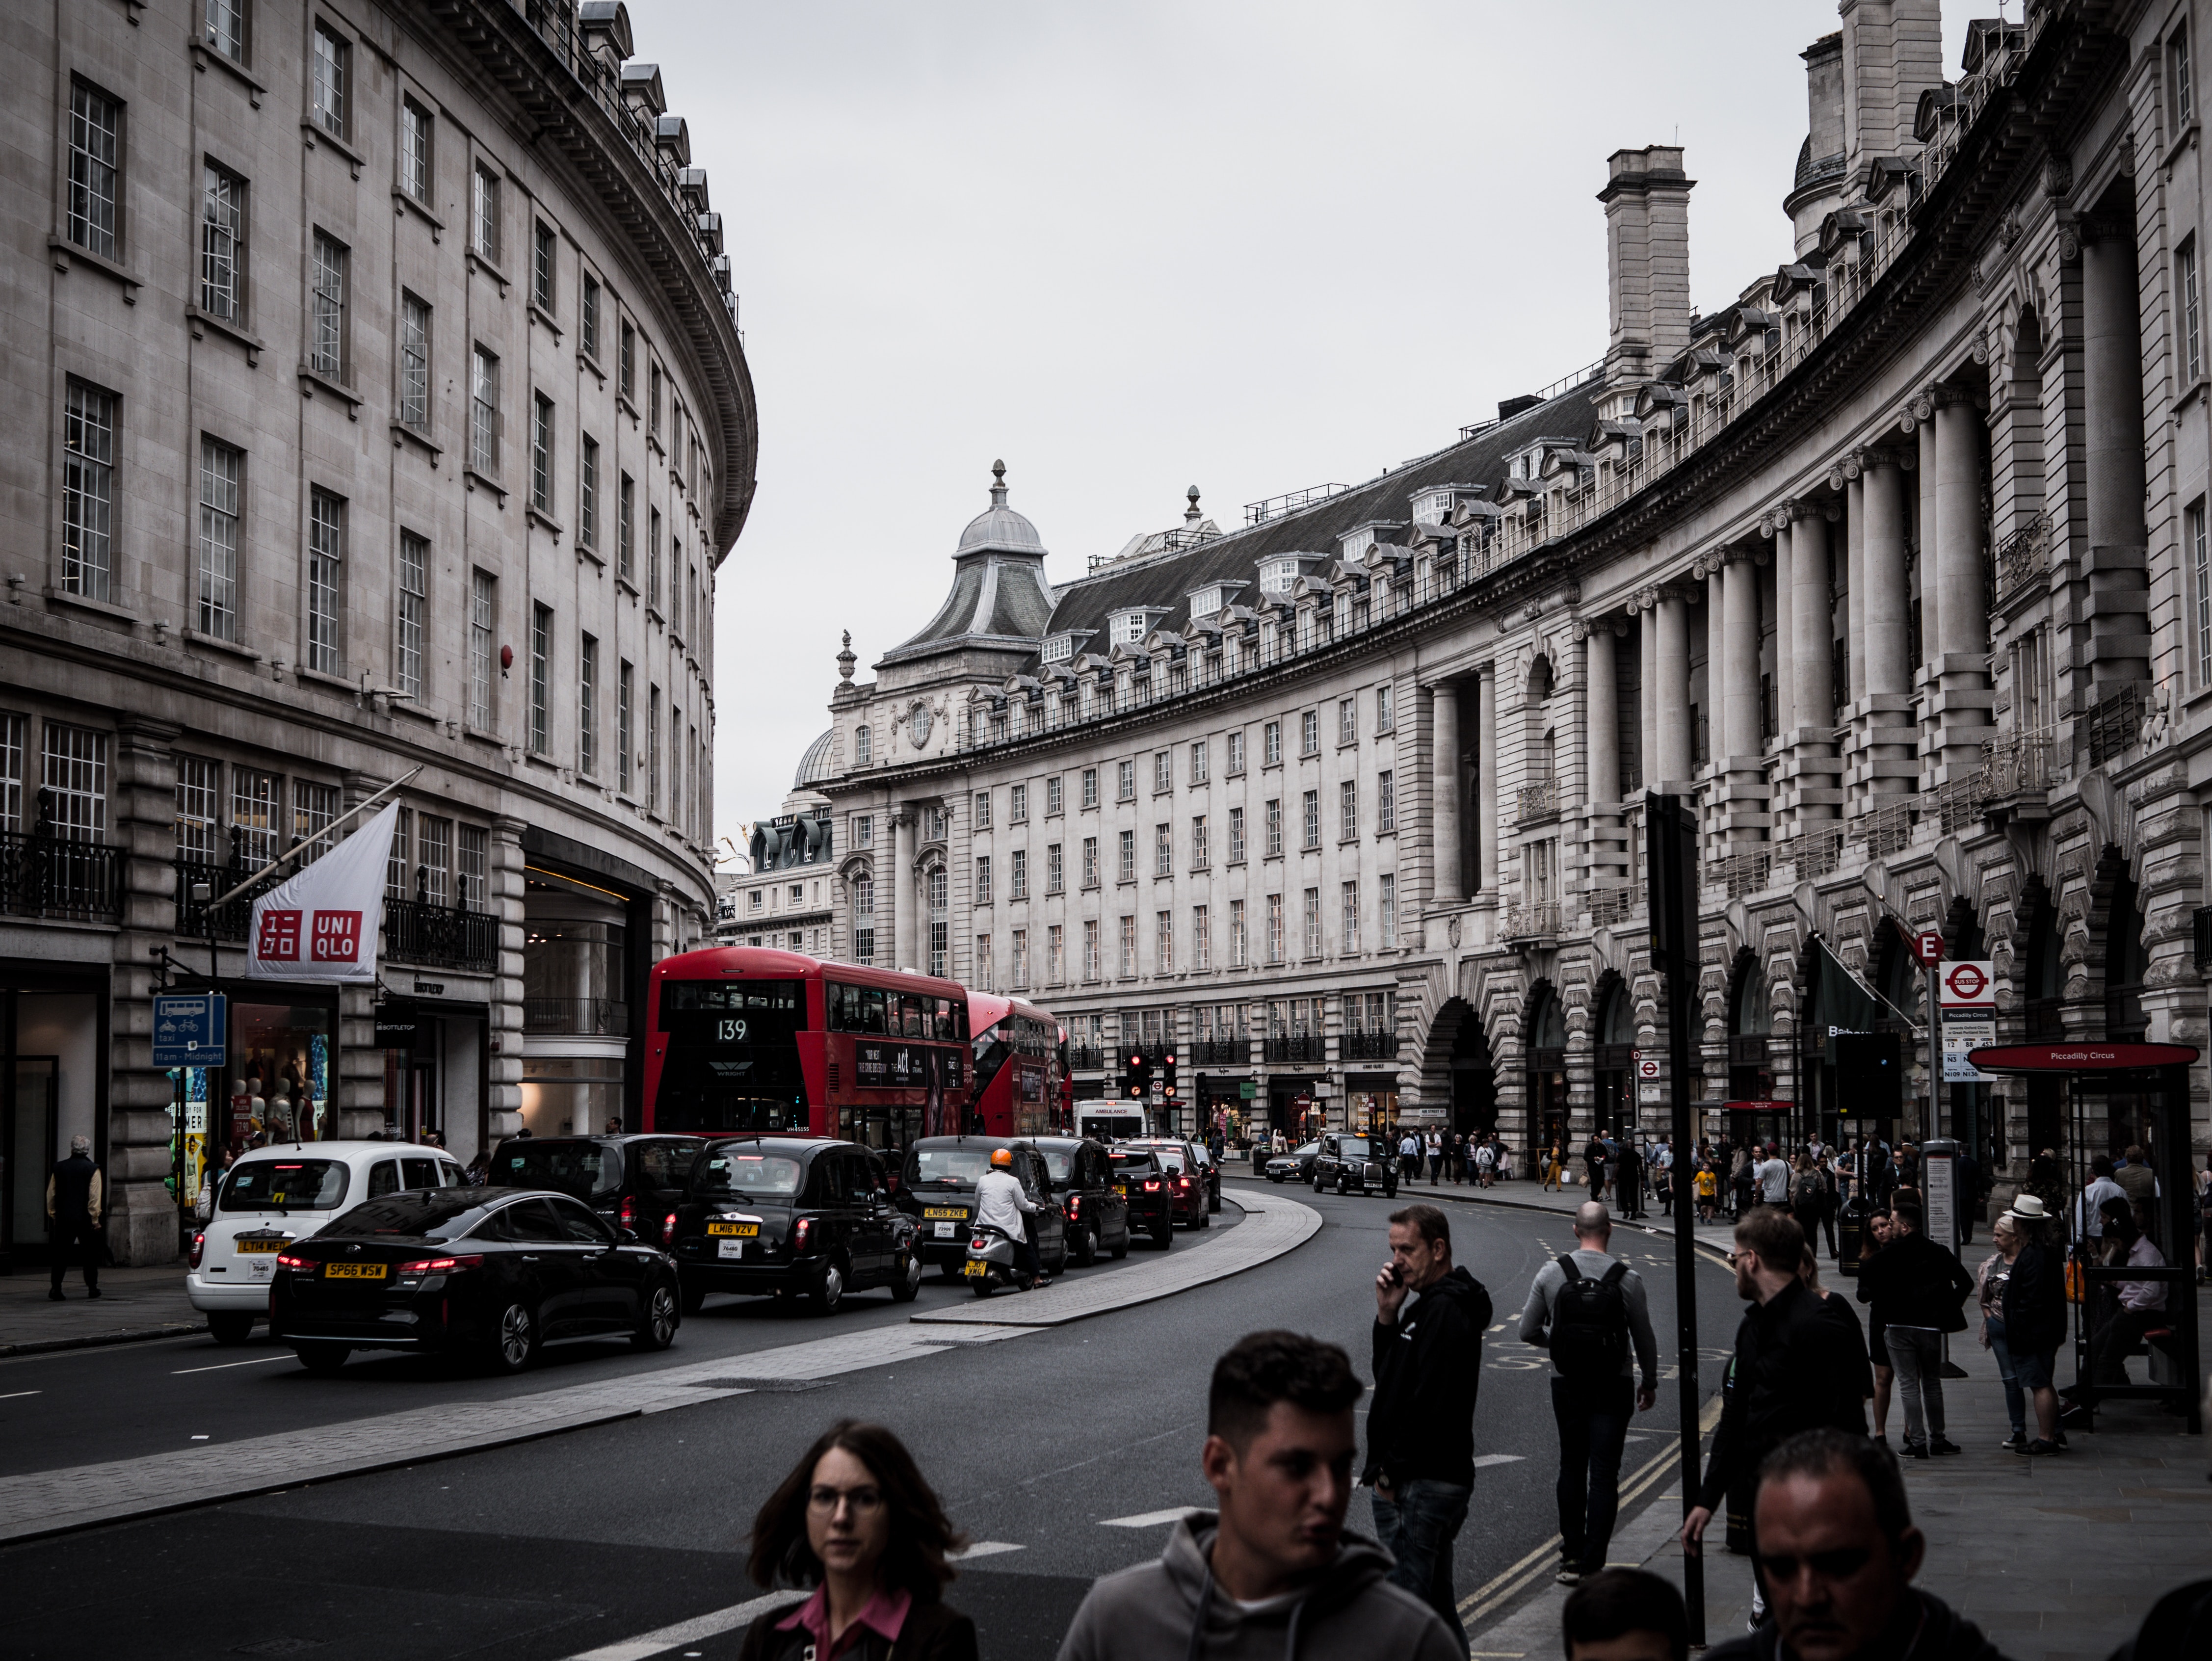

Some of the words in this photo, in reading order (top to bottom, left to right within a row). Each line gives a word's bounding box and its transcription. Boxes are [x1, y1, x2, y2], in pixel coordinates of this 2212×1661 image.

[317, 917, 353, 935] UNI
[316, 938, 353, 958] QLO
[1922, 937, 1936, 957] E
[419, 983, 444, 994] BOTTLETOP
[719, 1020, 746, 1040] 139
[156, 1053, 177, 1061] 11am
[184, 1052, 223, 1061] Midnight
[2051, 1052, 2088, 1060] Piccadilly
[713, 1224, 733, 1233] LM16
[736, 1225, 752, 1234] VZV
[243, 1241, 263, 1250] LT14
[267, 1241, 285, 1250] WED
[330, 1264, 358, 1275] SP66
[361, 1265, 383, 1276] WSW
